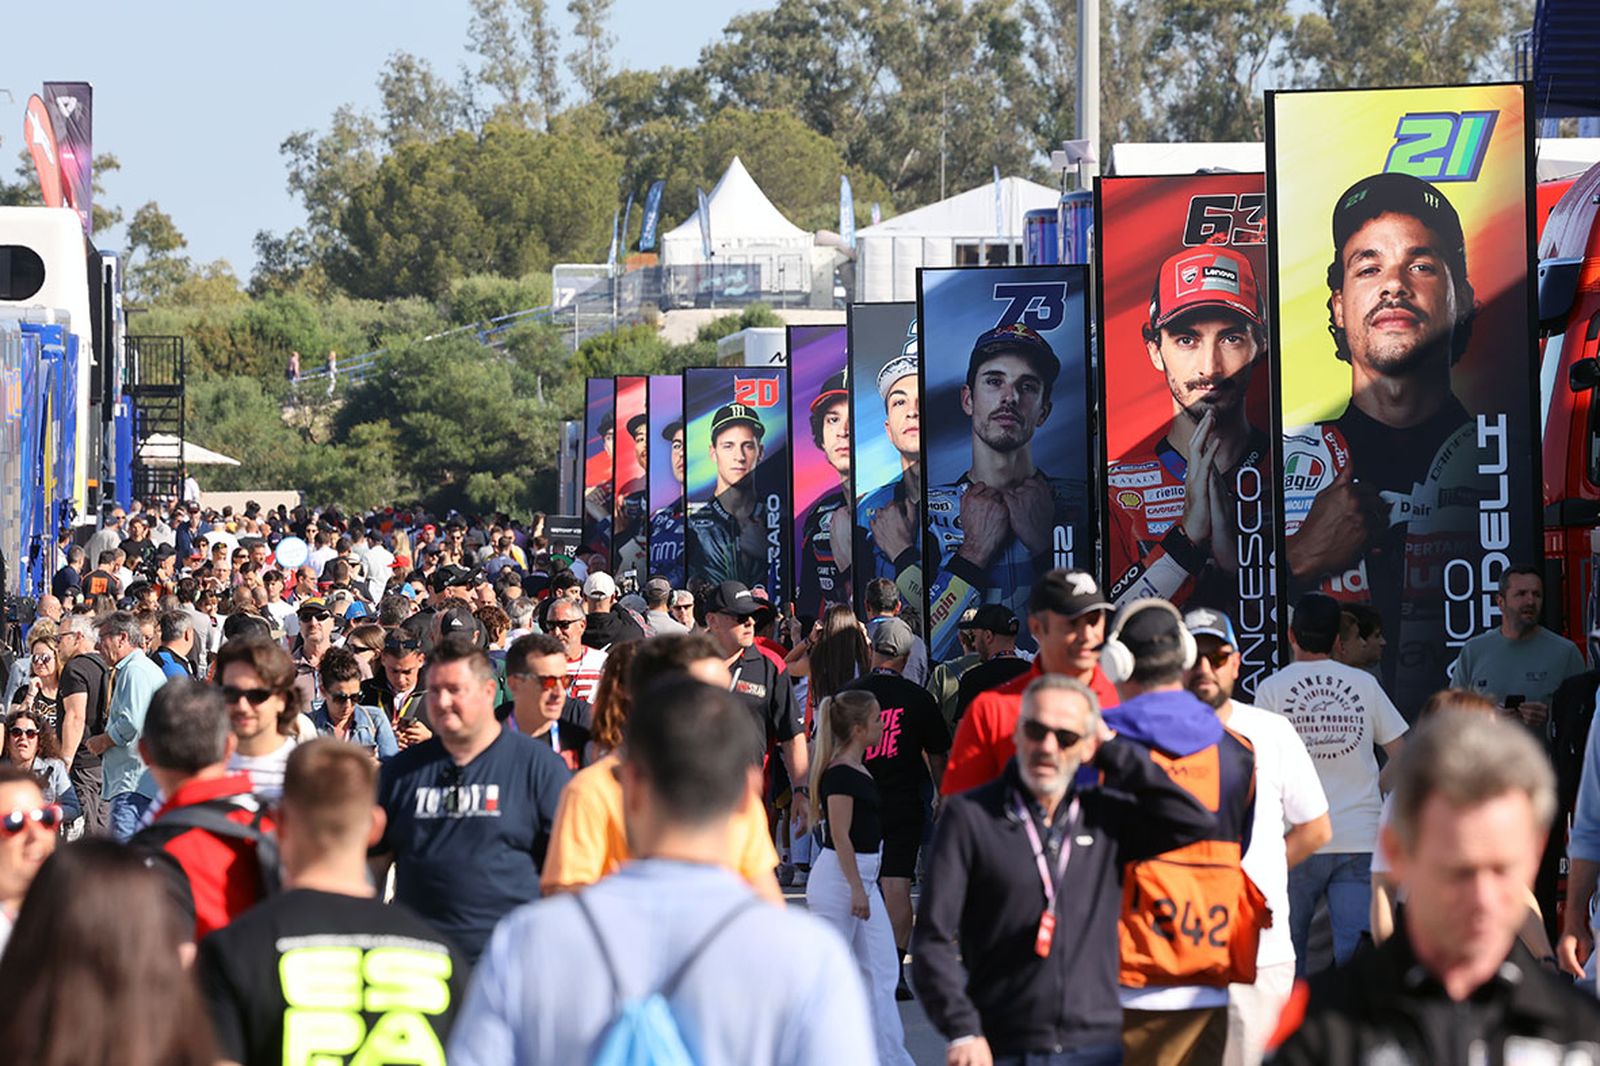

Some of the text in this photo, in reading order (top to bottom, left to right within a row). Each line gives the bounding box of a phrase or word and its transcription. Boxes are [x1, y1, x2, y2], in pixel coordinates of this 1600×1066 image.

[1383, 110, 1500, 183] 21
[1183, 193, 1267, 247] 63
[1204, 268, 1235, 280] Lenovo
[993, 282, 1067, 332] 73
[734, 375, 779, 407] 20
[1156, 487, 1185, 499] riello
[1443, 558, 1475, 680] CO
[1283, 675, 1365, 714] ALPINESTARS
